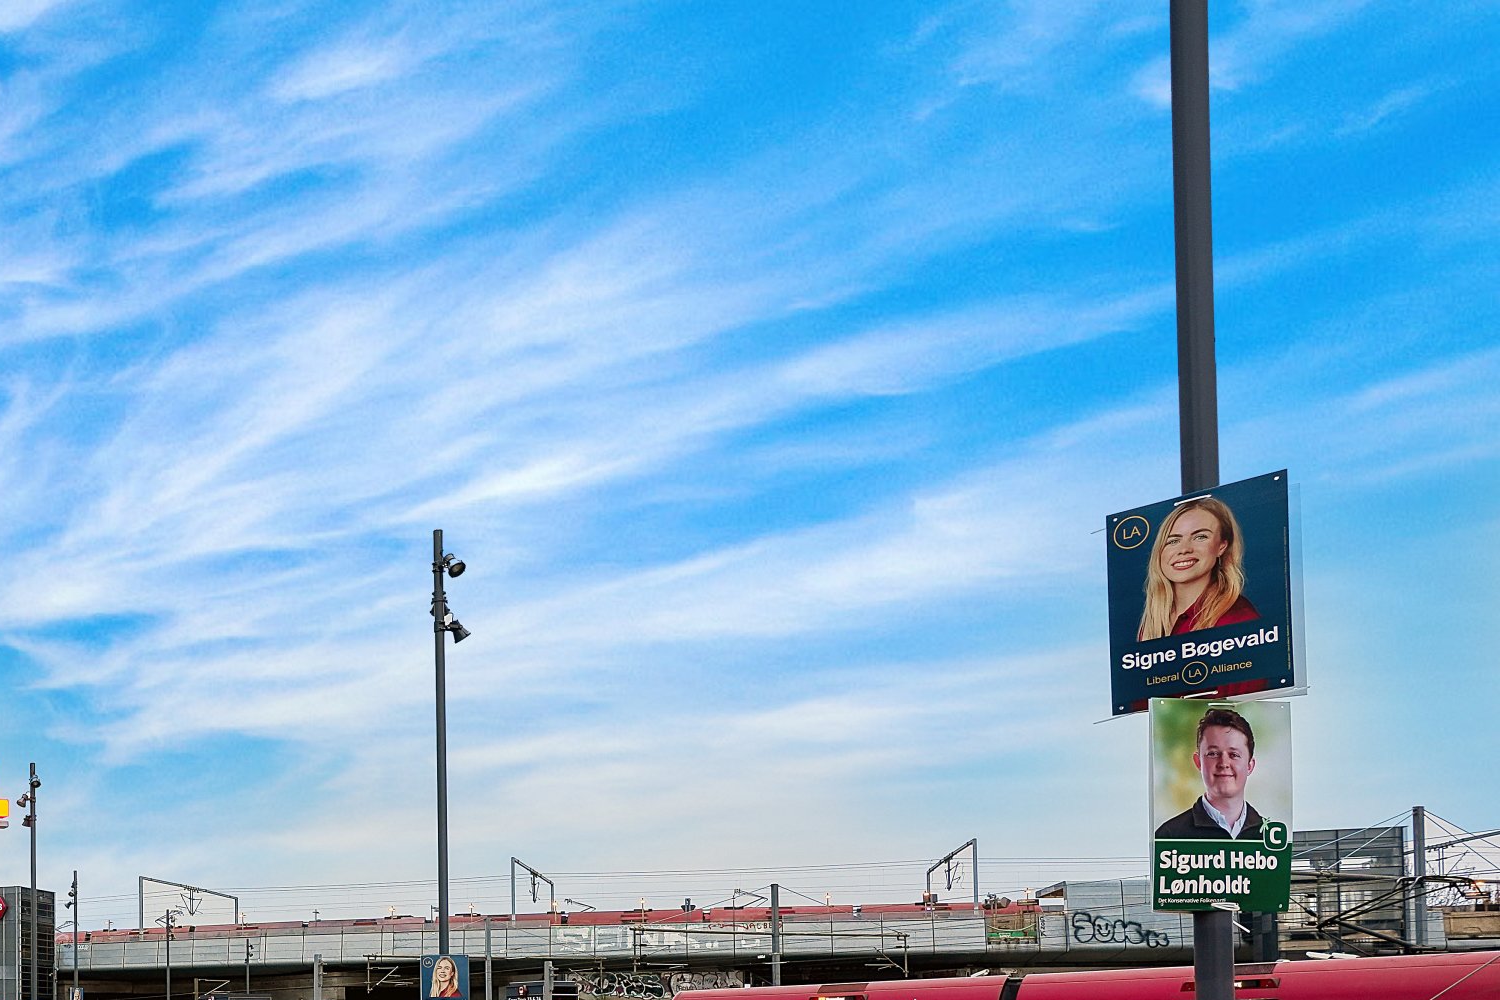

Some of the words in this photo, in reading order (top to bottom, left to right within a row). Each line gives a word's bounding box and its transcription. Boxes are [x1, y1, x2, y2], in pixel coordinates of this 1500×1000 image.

[1122, 525, 1142, 541] LA
[1121, 648, 1177, 672] Signe
[1181, 625, 1279, 660] Bøgevald
[1146, 671, 1181, 686] Liberal
[1188, 667, 1203, 679] LA
[1211, 659, 1253, 675] Alliance
[1269, 826, 1282, 845] C
[1159, 849, 1226, 875] Sigurd
[1230, 850, 1278, 871] Hebo
[1159, 874, 1251, 895] Lønholdt
